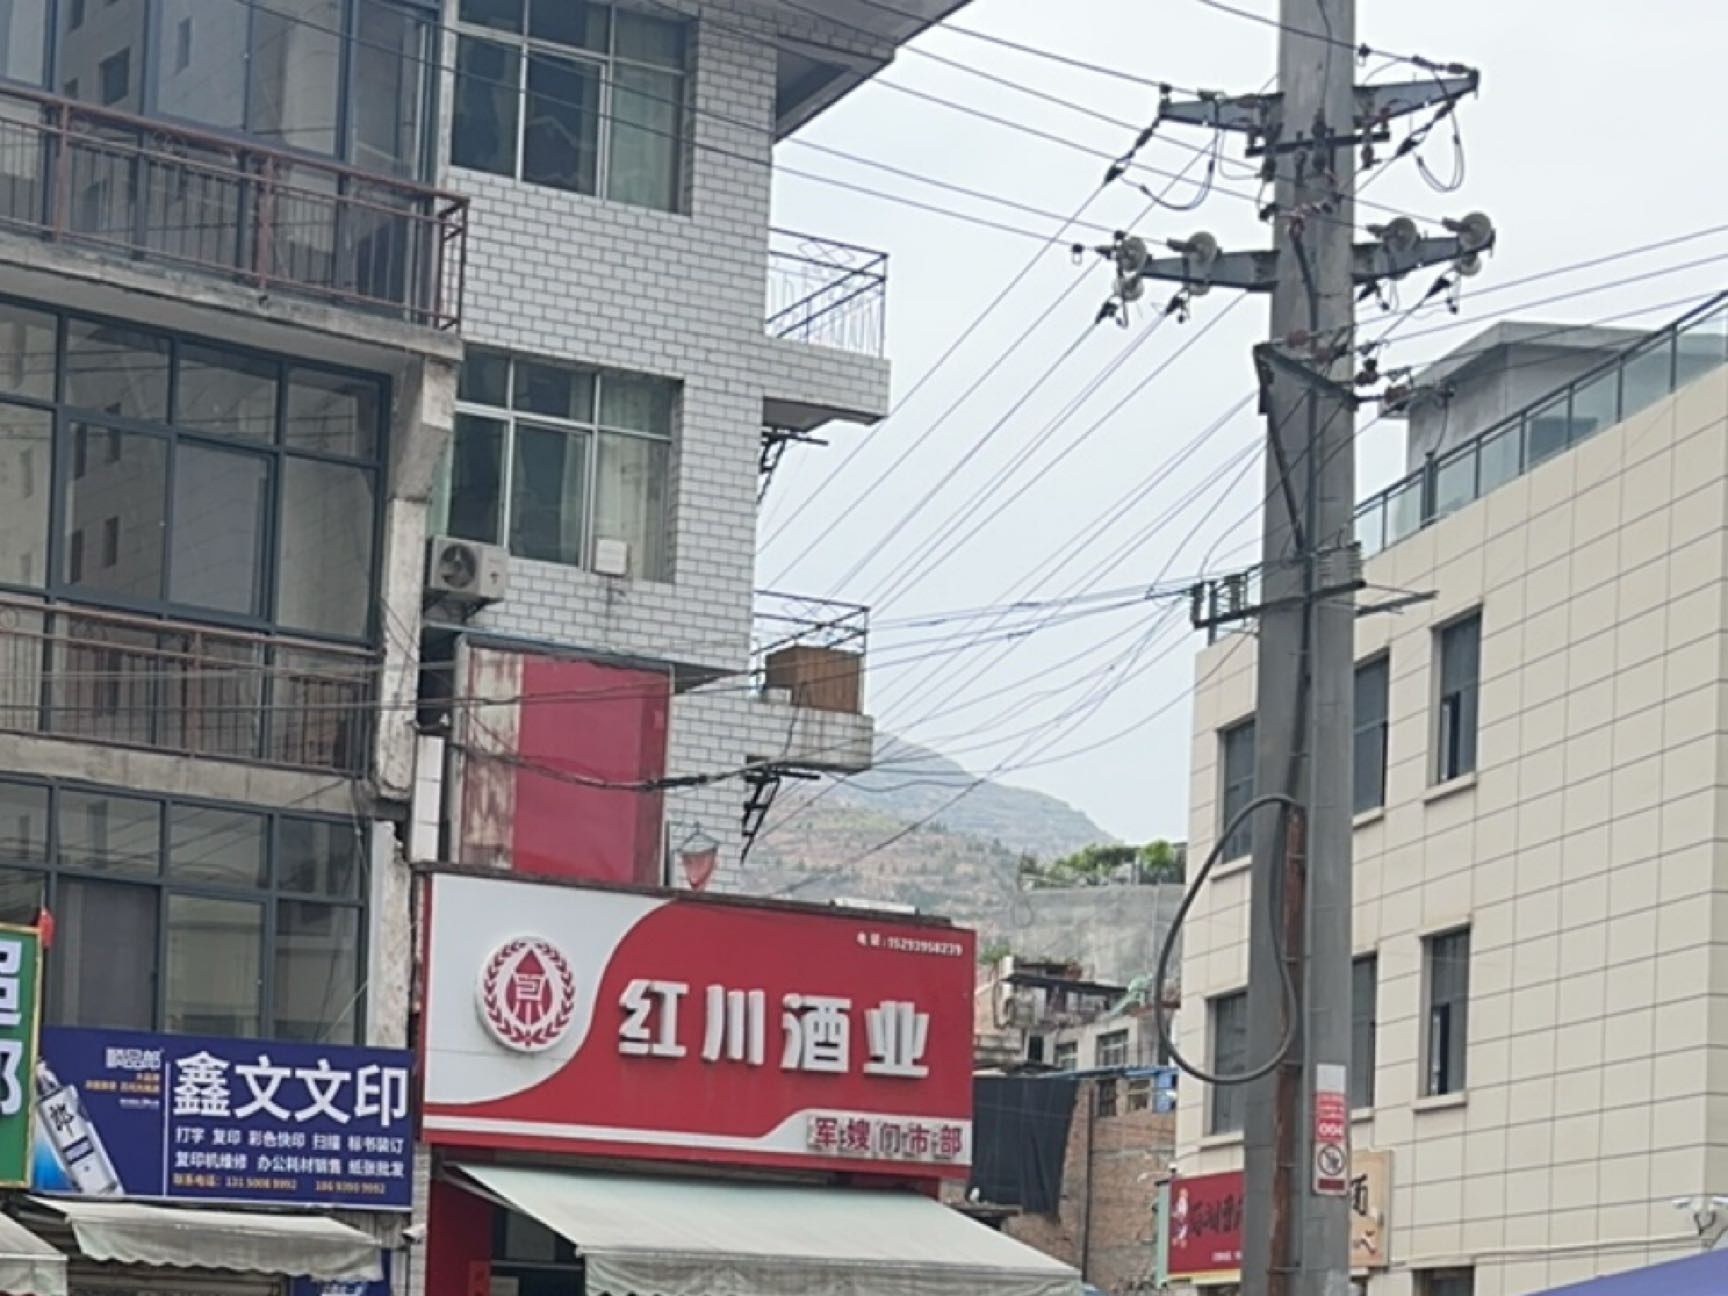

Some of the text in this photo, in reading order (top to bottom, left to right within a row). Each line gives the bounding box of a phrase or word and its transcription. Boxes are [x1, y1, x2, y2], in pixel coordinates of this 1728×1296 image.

[619, 978, 931, 1078] 红川酒业
[173, 1051, 407, 1127] 鑫文文印
